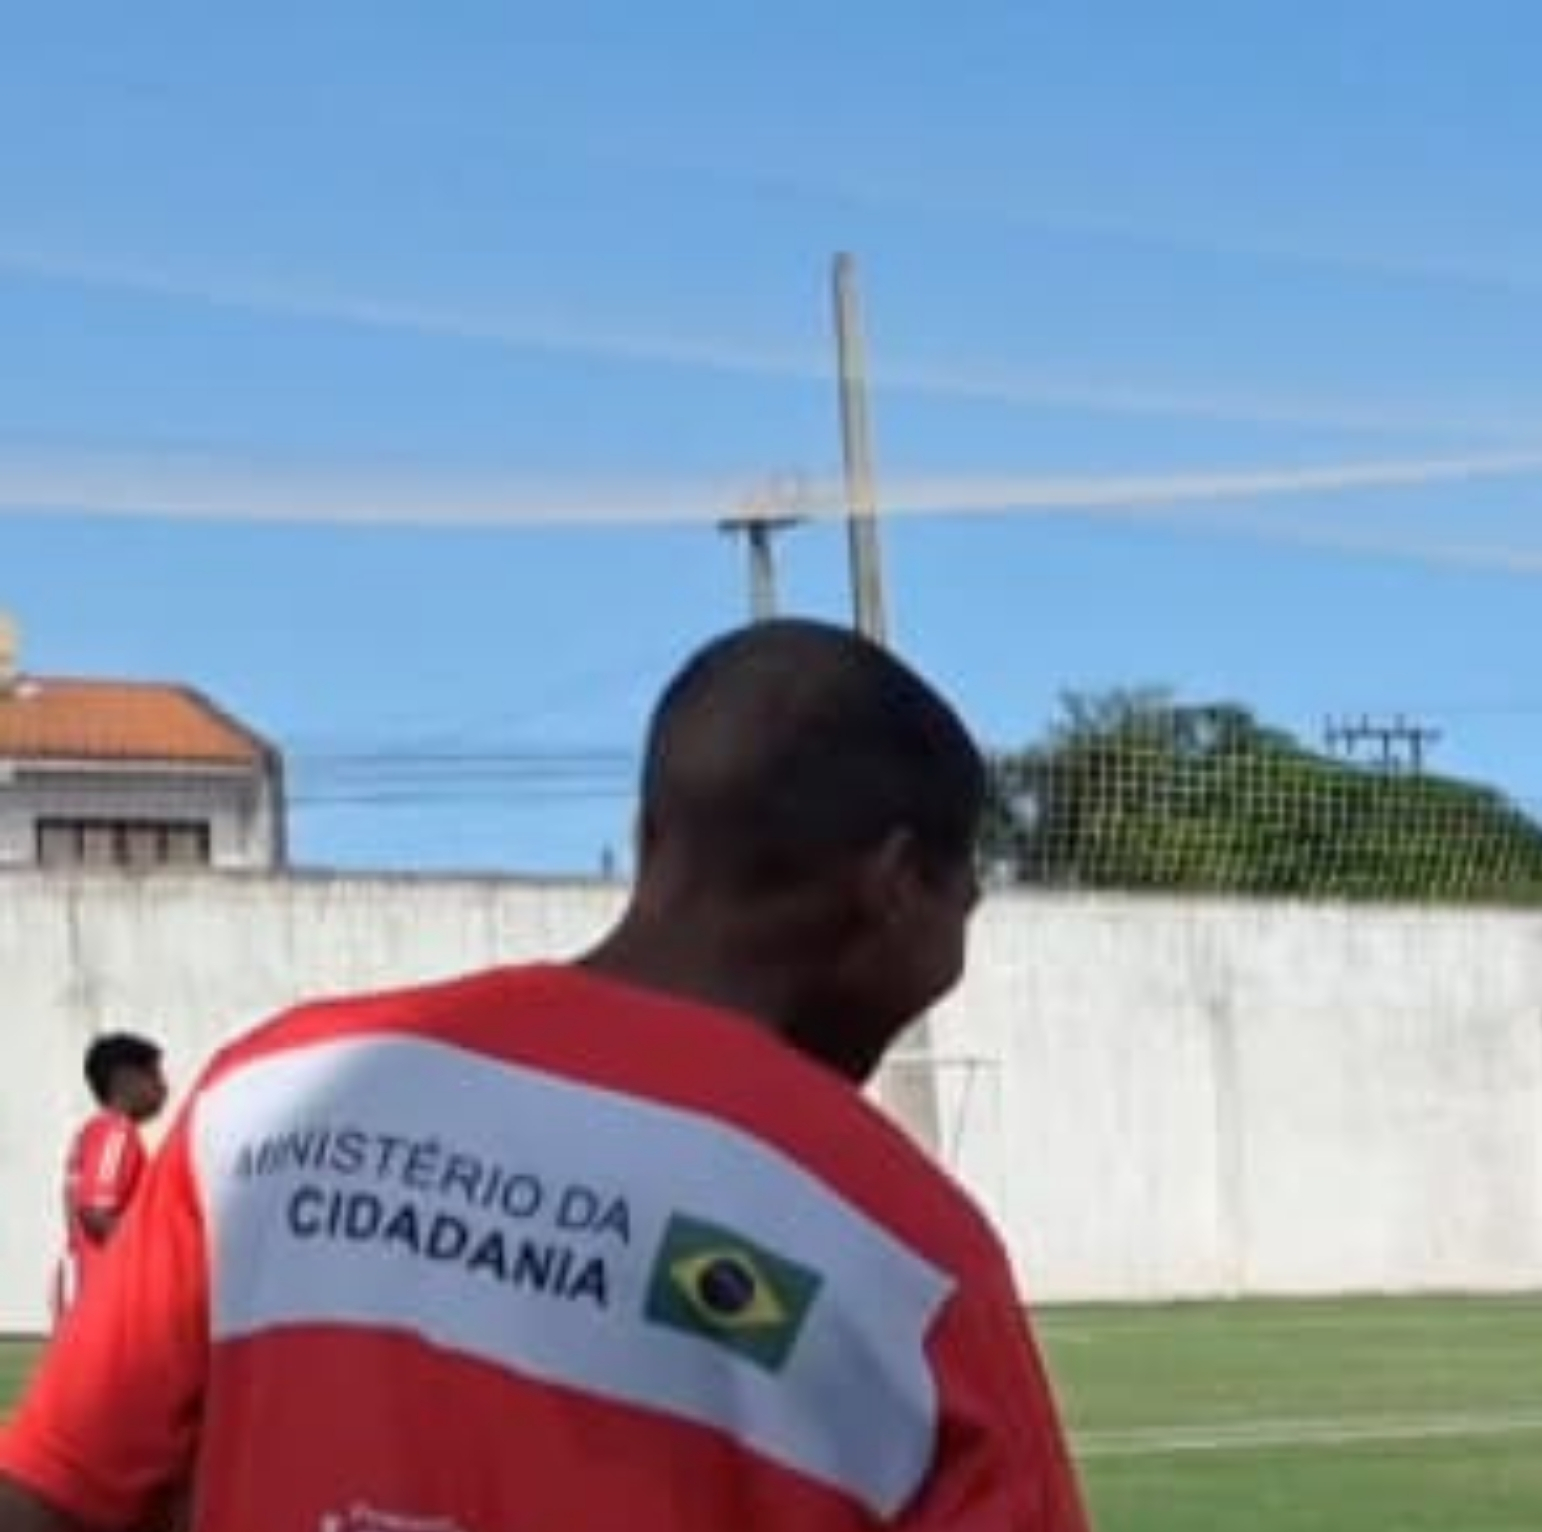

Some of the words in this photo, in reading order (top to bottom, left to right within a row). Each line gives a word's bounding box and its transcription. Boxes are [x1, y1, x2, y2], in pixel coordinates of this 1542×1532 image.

[235, 1122, 544, 1220] MINISTÉRIO
[555, 1184, 632, 1246] DA
[287, 1184, 608, 1310] CIDADANIA
